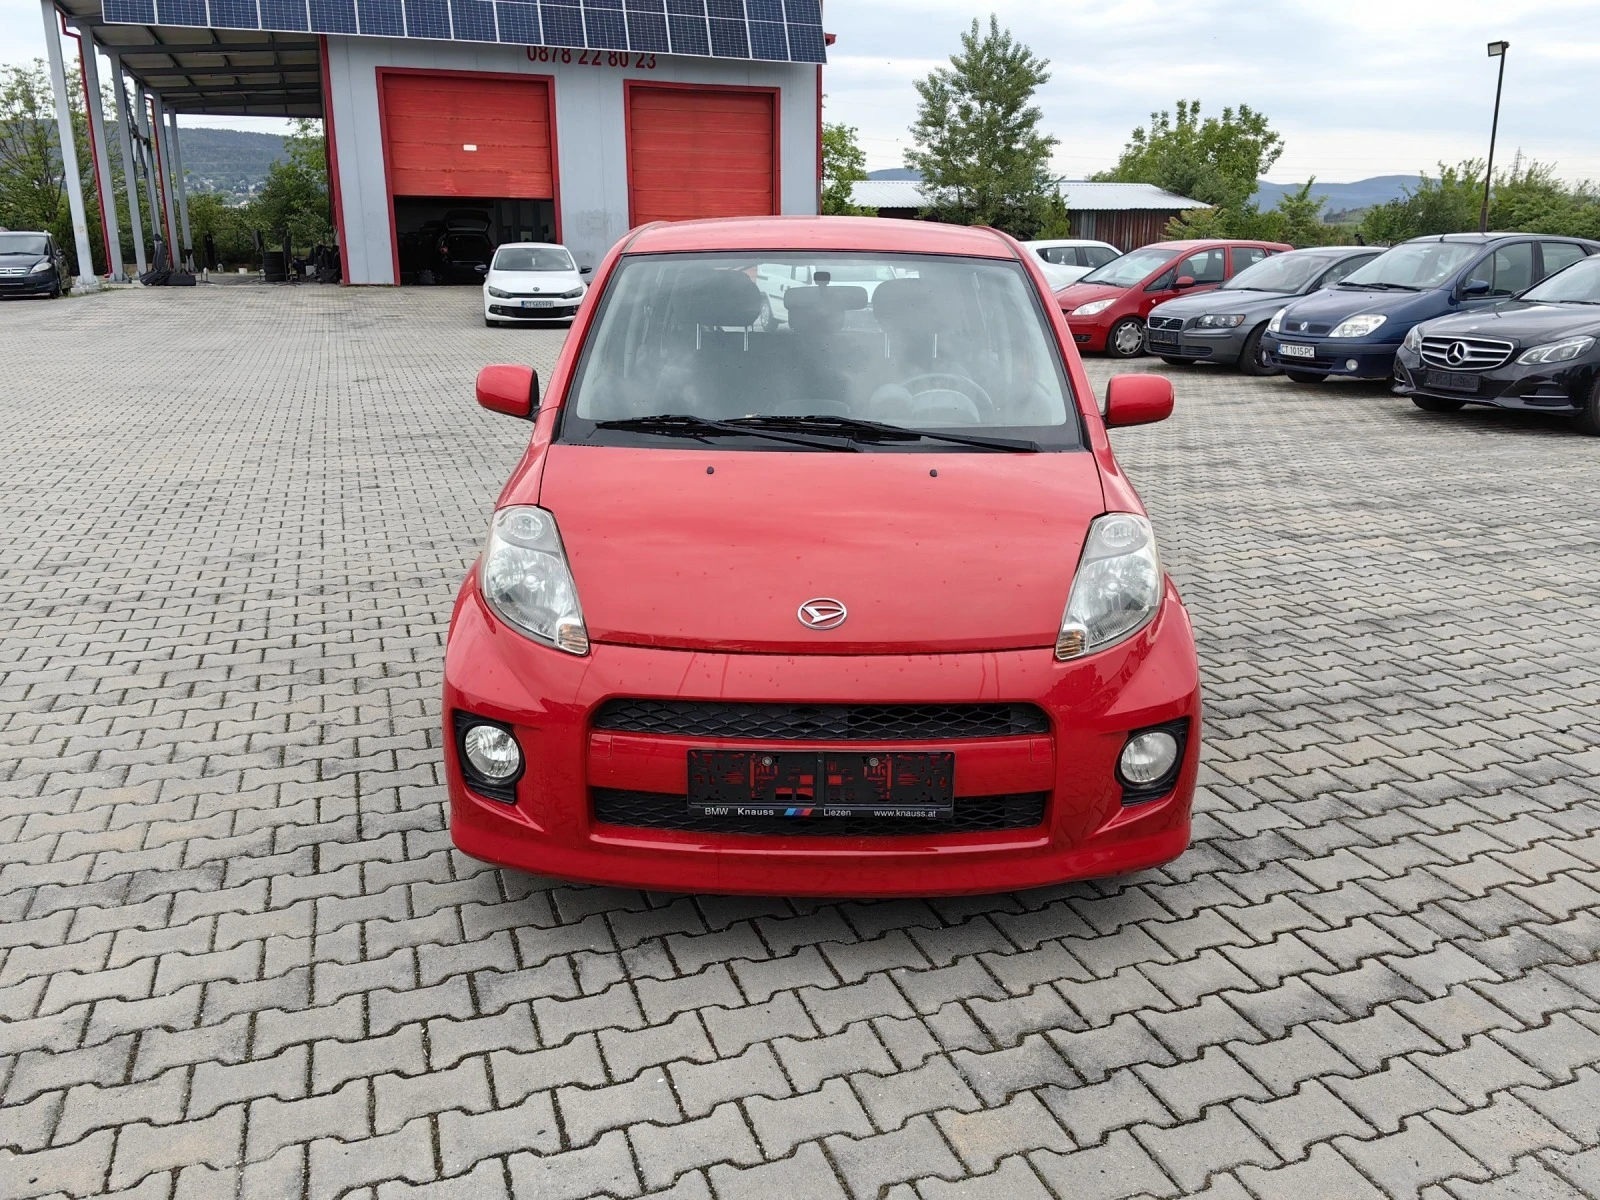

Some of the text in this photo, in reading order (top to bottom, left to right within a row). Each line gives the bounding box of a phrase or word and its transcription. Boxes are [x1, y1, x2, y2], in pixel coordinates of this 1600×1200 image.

[578, 48, 602, 65] 22
[608, 50, 629, 67] 80
[635, 53, 657, 69] 23
[704, 807, 937, 818] BMW Knauss Liezen www.knauss.at
